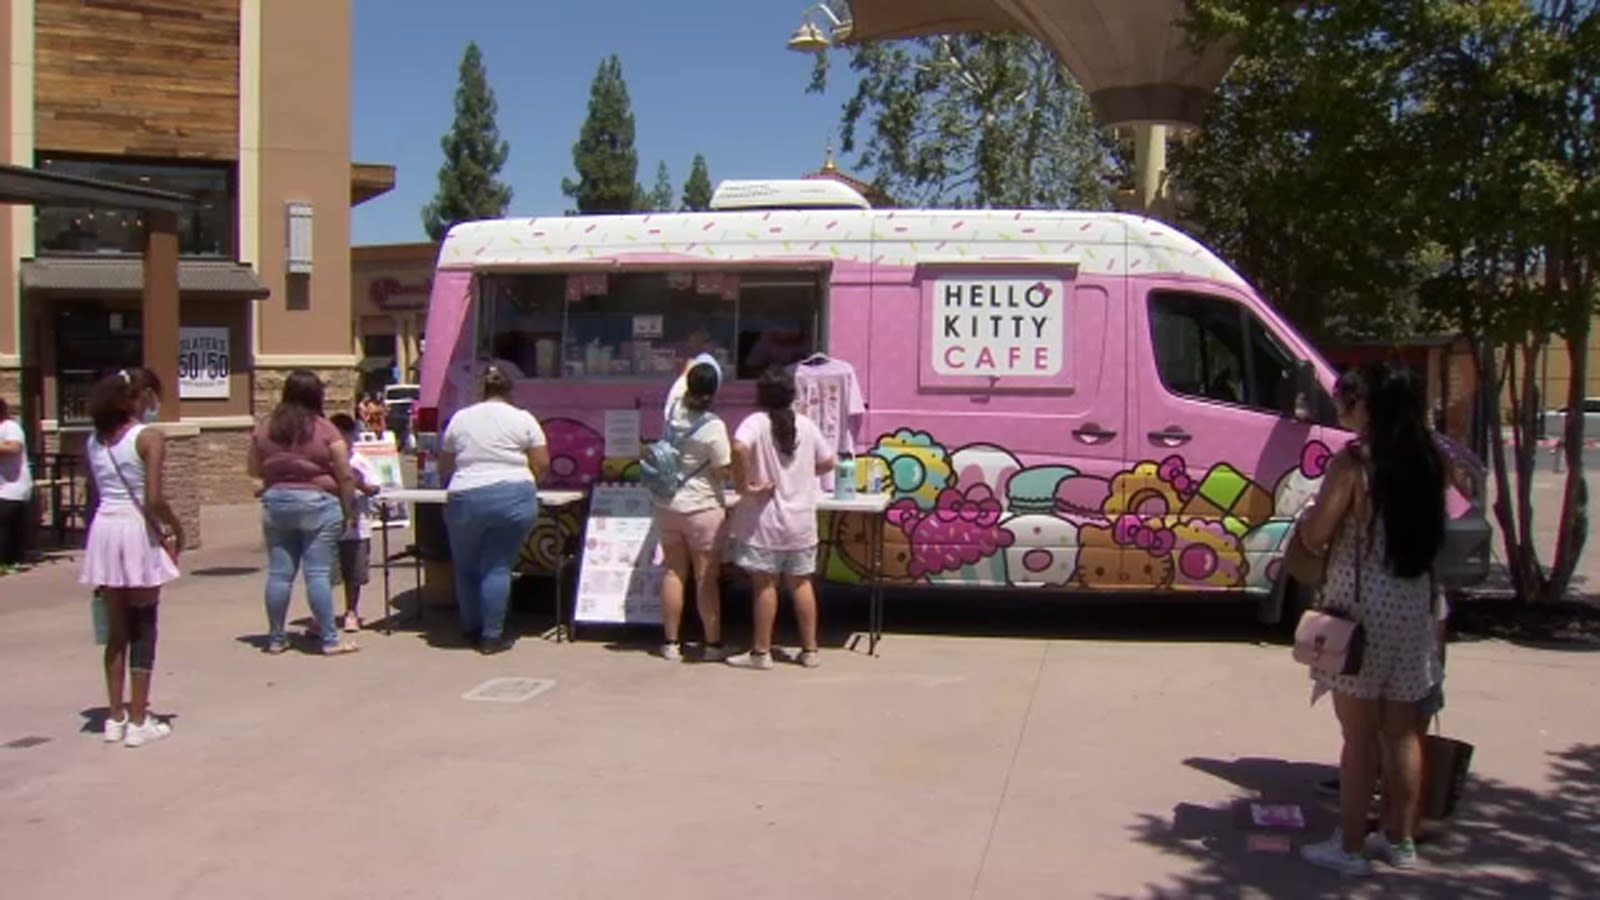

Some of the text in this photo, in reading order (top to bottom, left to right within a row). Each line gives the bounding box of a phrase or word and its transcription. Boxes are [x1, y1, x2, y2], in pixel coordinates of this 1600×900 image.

[945, 283, 1049, 308] HELLO
[945, 315, 1047, 338] KITTY
[178, 352, 229, 380] 50/50
[944, 346, 1048, 369] CAFE
